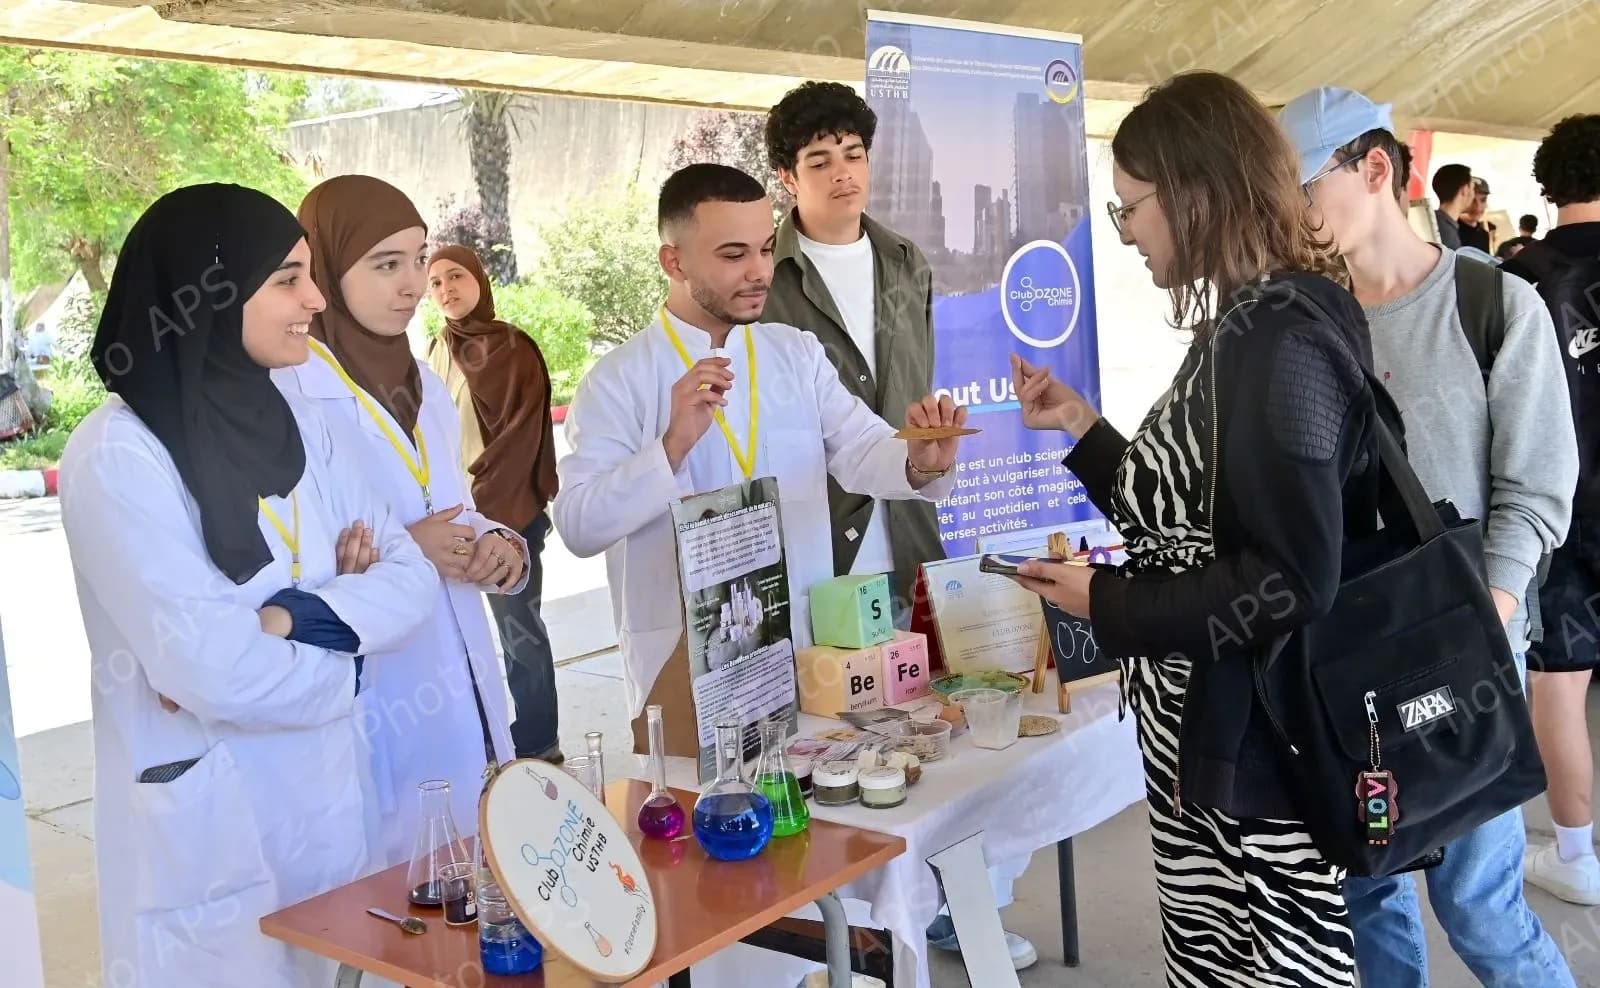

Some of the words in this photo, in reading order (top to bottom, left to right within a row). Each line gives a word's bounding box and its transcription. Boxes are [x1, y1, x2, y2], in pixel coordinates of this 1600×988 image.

[870, 89, 908, 99] USTHB
[1010, 289, 1033, 300] Club
[1035, 287, 1073, 299] OZONE
[1047, 297, 1073, 307] Chimie
[968, 458, 985, 470] est
[988, 457, 1003, 468] un
[1006, 453, 1031, 465] club
[957, 475, 980, 489] tout
[983, 473, 989, 485] à
[992, 465, 1050, 485] vulgariser
[1052, 463, 1062, 476] la
[984, 489, 1004, 501] son
[1008, 483, 1034, 497] côté
[1038, 479, 1084, 494] magiqu
[962, 510, 976, 521] au
[983, 500, 1039, 519] quotidien
[1047, 496, 1060, 508] et
[1067, 492, 1087, 504] cela
[979, 518, 1028, 535] activités
[860, 586, 867, 596] 16
[871, 599, 881, 620] S
[890, 650, 899, 660] 26
[846, 661, 851, 670] 4
[897, 662, 920, 682] Fe
[850, 675, 875, 696] Be
[905, 686, 917, 695] iron
[572, 816, 596, 863] Chimie
[537, 867, 560, 902] Club
[550, 799, 584, 868] OZONE
[586, 832, 608, 873] USTHB
